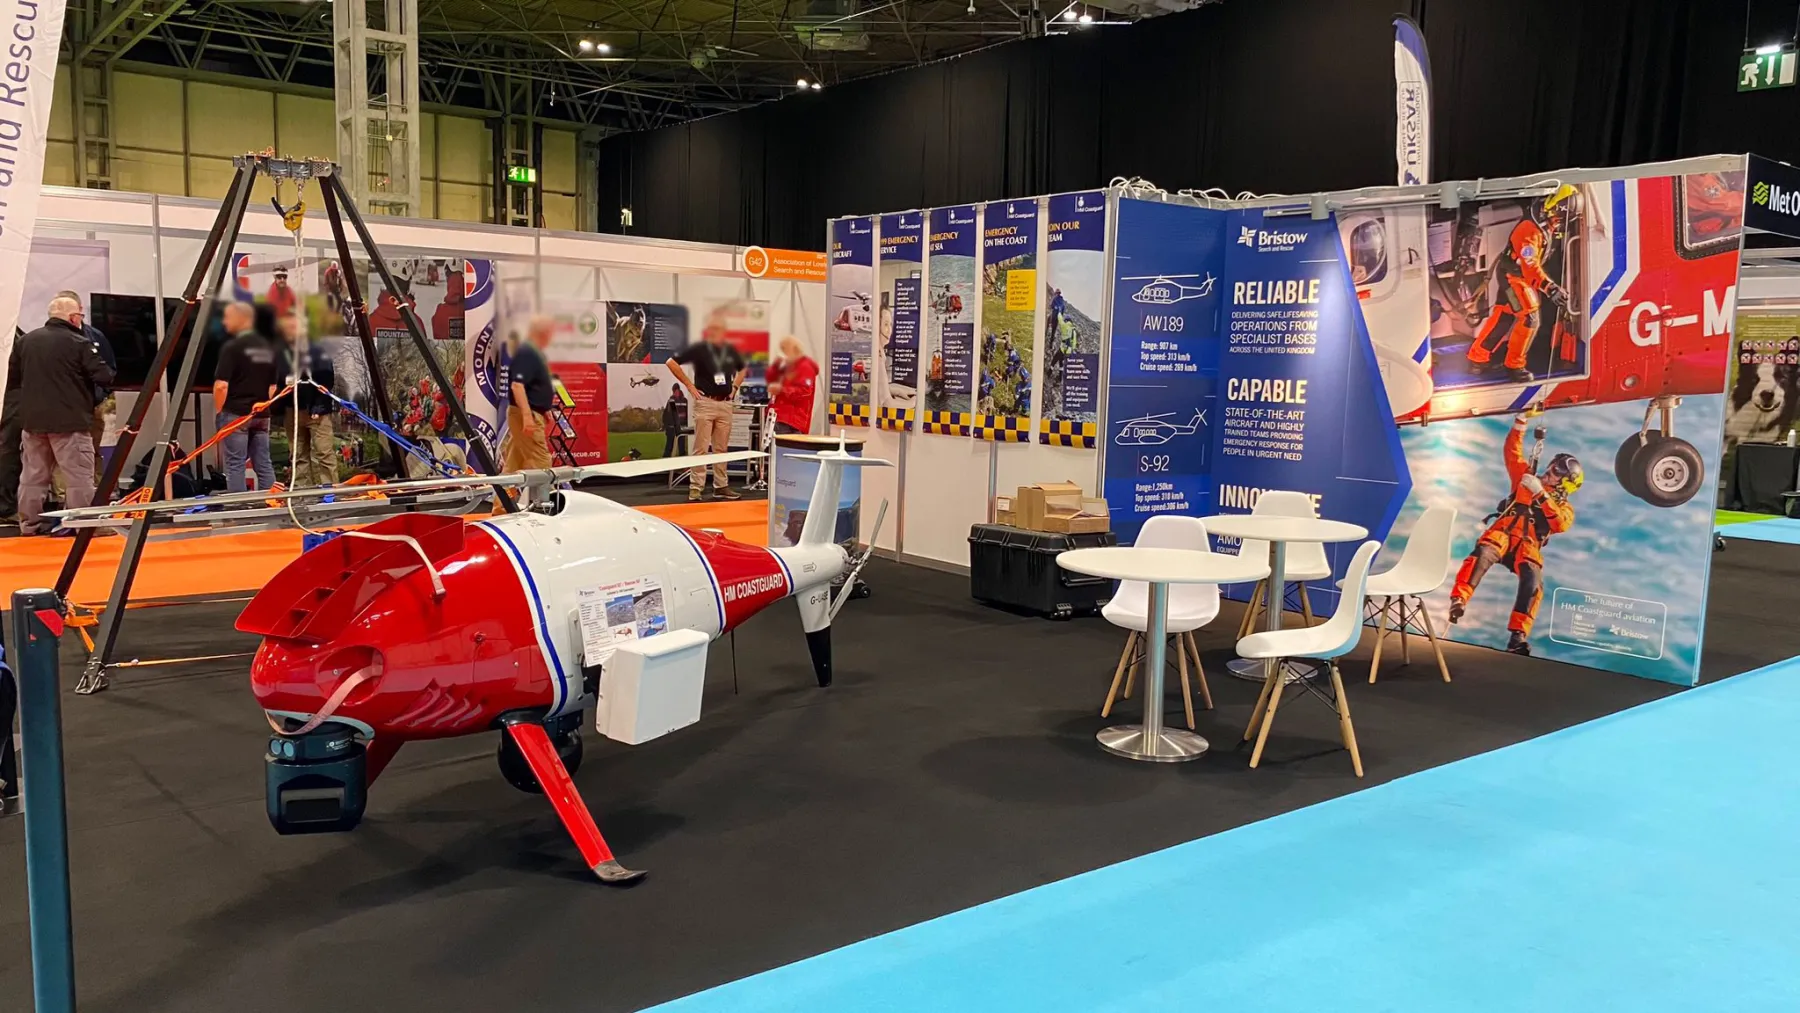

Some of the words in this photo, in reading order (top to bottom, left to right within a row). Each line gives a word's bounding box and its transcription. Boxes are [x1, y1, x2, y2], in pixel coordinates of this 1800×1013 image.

[1769, 184, 1790, 214] Met
[985, 226, 1018, 237] EMERGENCY
[1049, 223, 1060, 231] OIN
[1062, 221, 1079, 230] OUR
[888, 236, 919, 244] EMERGENCY
[994, 238, 1005, 246] THE
[1005, 236, 1028, 245] COAST
[1049, 233, 1062, 242] EAM
[1258, 230, 1308, 246] Bristow
[880, 246, 896, 254] ERVICE
[749, 257, 762, 266] G42
[774, 258, 806, 266] Association
[774, 266, 793, 274] Search
[1234, 279, 1320, 305] RELIABLE
[1143, 314, 1184, 332] AW189
[1231, 321, 1287, 331] OPERATIONS
[1289, 321, 1318, 331] FROM
[1230, 334, 1282, 344] SPECIALIST
[1284, 334, 1317, 344] BASES
[1141, 341, 1158, 351] Range:
[1170, 342, 1178, 350] km
[1141, 352, 1149, 362] Top
[1150, 353, 1167, 362] speed:
[1178, 353, 1190, 361] km/h
[1140, 362, 1156, 370] Cruise
[1157, 363, 1173, 372] speed:
[1227, 378, 1307, 404] CAPABLE
[1225, 407, 1305, 420] STATE-OF-THE-ART
[1224, 419, 1259, 428] AIRCRAFT
[1260, 421, 1275, 429] AND
[1277, 422, 1304, 431] HIGHLY
[1270, 432, 1303, 440] PROVIDING
[1223, 438, 1258, 446] EMERGENCY
[1259, 441, 1289, 449] RESPONSE
[1223, 448, 1246, 456] PEOPLE
[1255, 450, 1282, 459] URGENT
[1284, 452, 1302, 460] NEED
[1140, 455, 1170, 472] S-92
[1135, 494, 1143, 503] Top
[1144, 493, 1160, 502] speed:
[1172, 492, 1184, 500] km/h
[1219, 484, 1322, 519] INNOE
[1135, 504, 1150, 512] Cruise
[1177, 501, 1189, 509] km/h
[724, 585, 736, 603] HM
[736, 573, 783, 599] COASTGUARD
[1584, 595, 1598, 604] The
[1600, 598, 1623, 609] future
[1561, 602, 1576, 611] HM
[1578, 605, 1621, 619] Coastguard
[1623, 613, 1656, 624] aviation
[1620, 628, 1648, 639] Bristow
